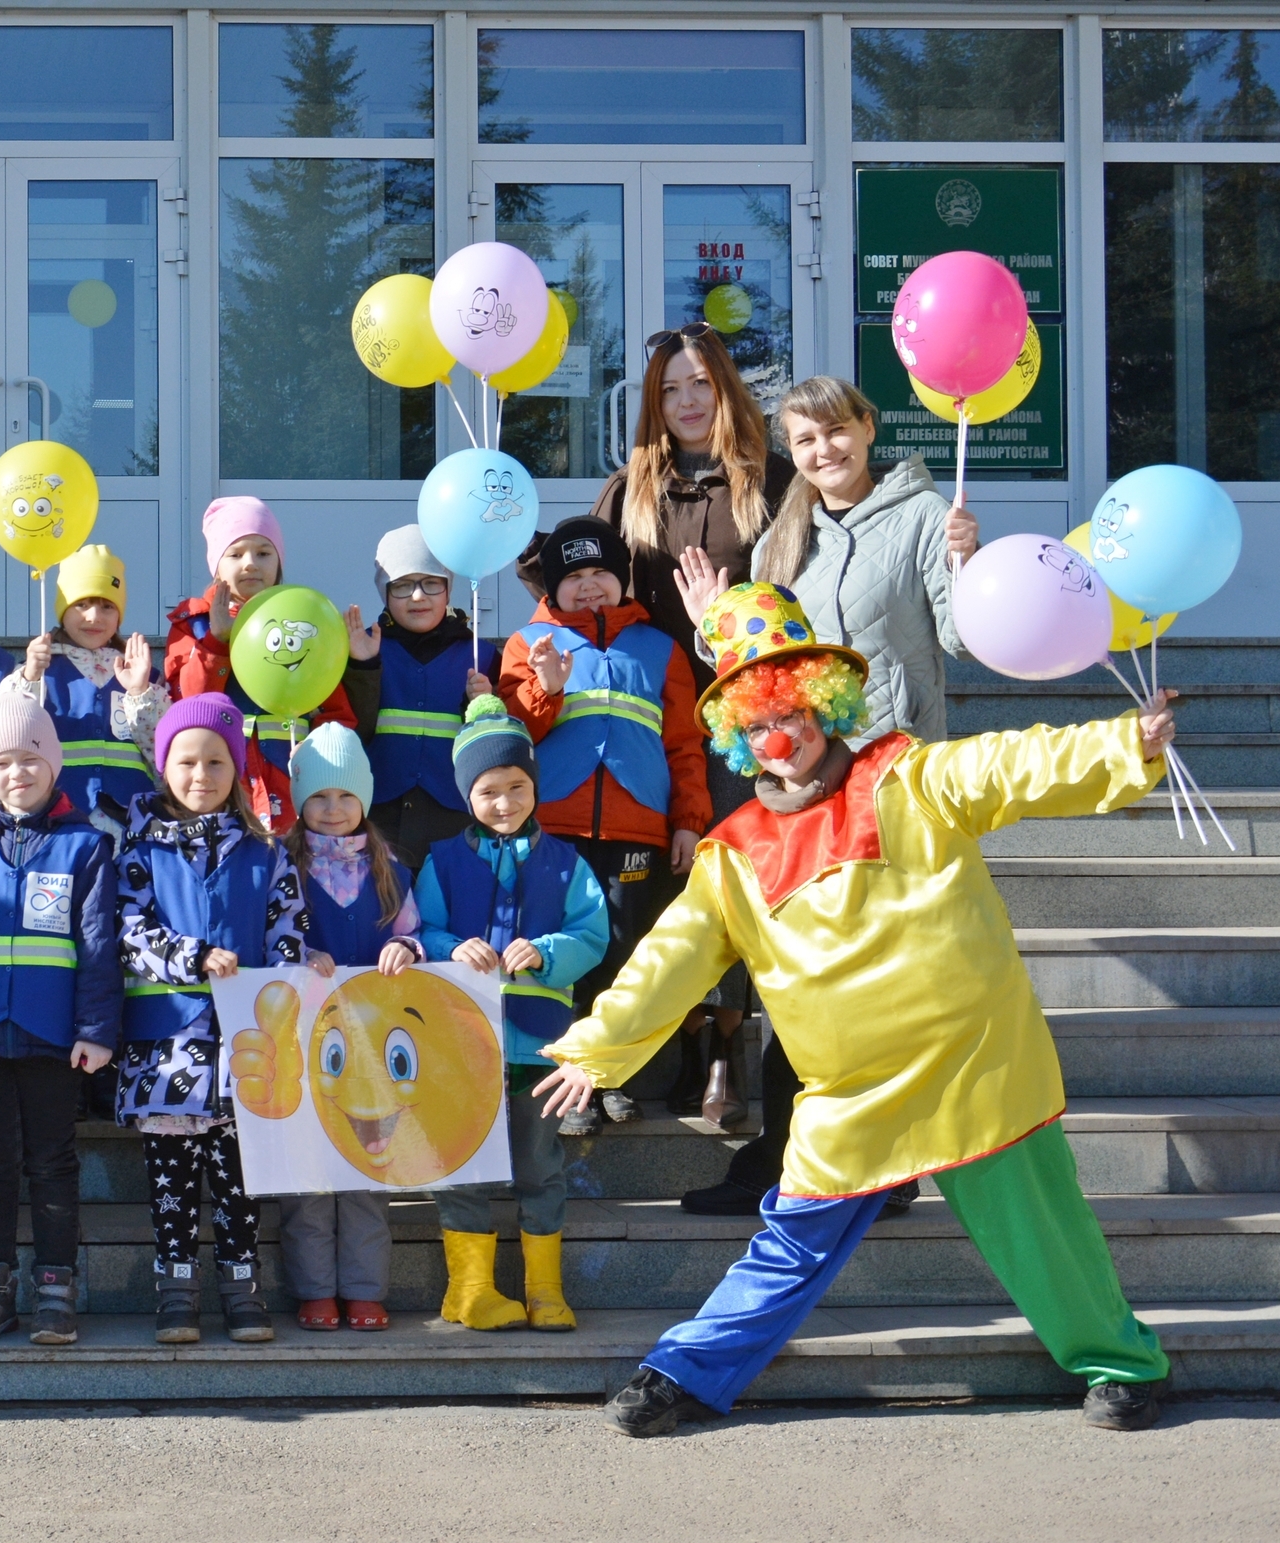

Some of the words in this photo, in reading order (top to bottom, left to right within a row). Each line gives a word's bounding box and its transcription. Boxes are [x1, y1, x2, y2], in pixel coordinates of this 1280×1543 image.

[698, 243, 744, 260] ВХОД
[864, 255, 898, 268] СОВЕТ
[1009, 253, 1053, 268] РАЙОНА
[896, 427, 984, 441] БЕЛЕБЕЕВСИЙ
[37, 876, 69, 888] ЮИД
